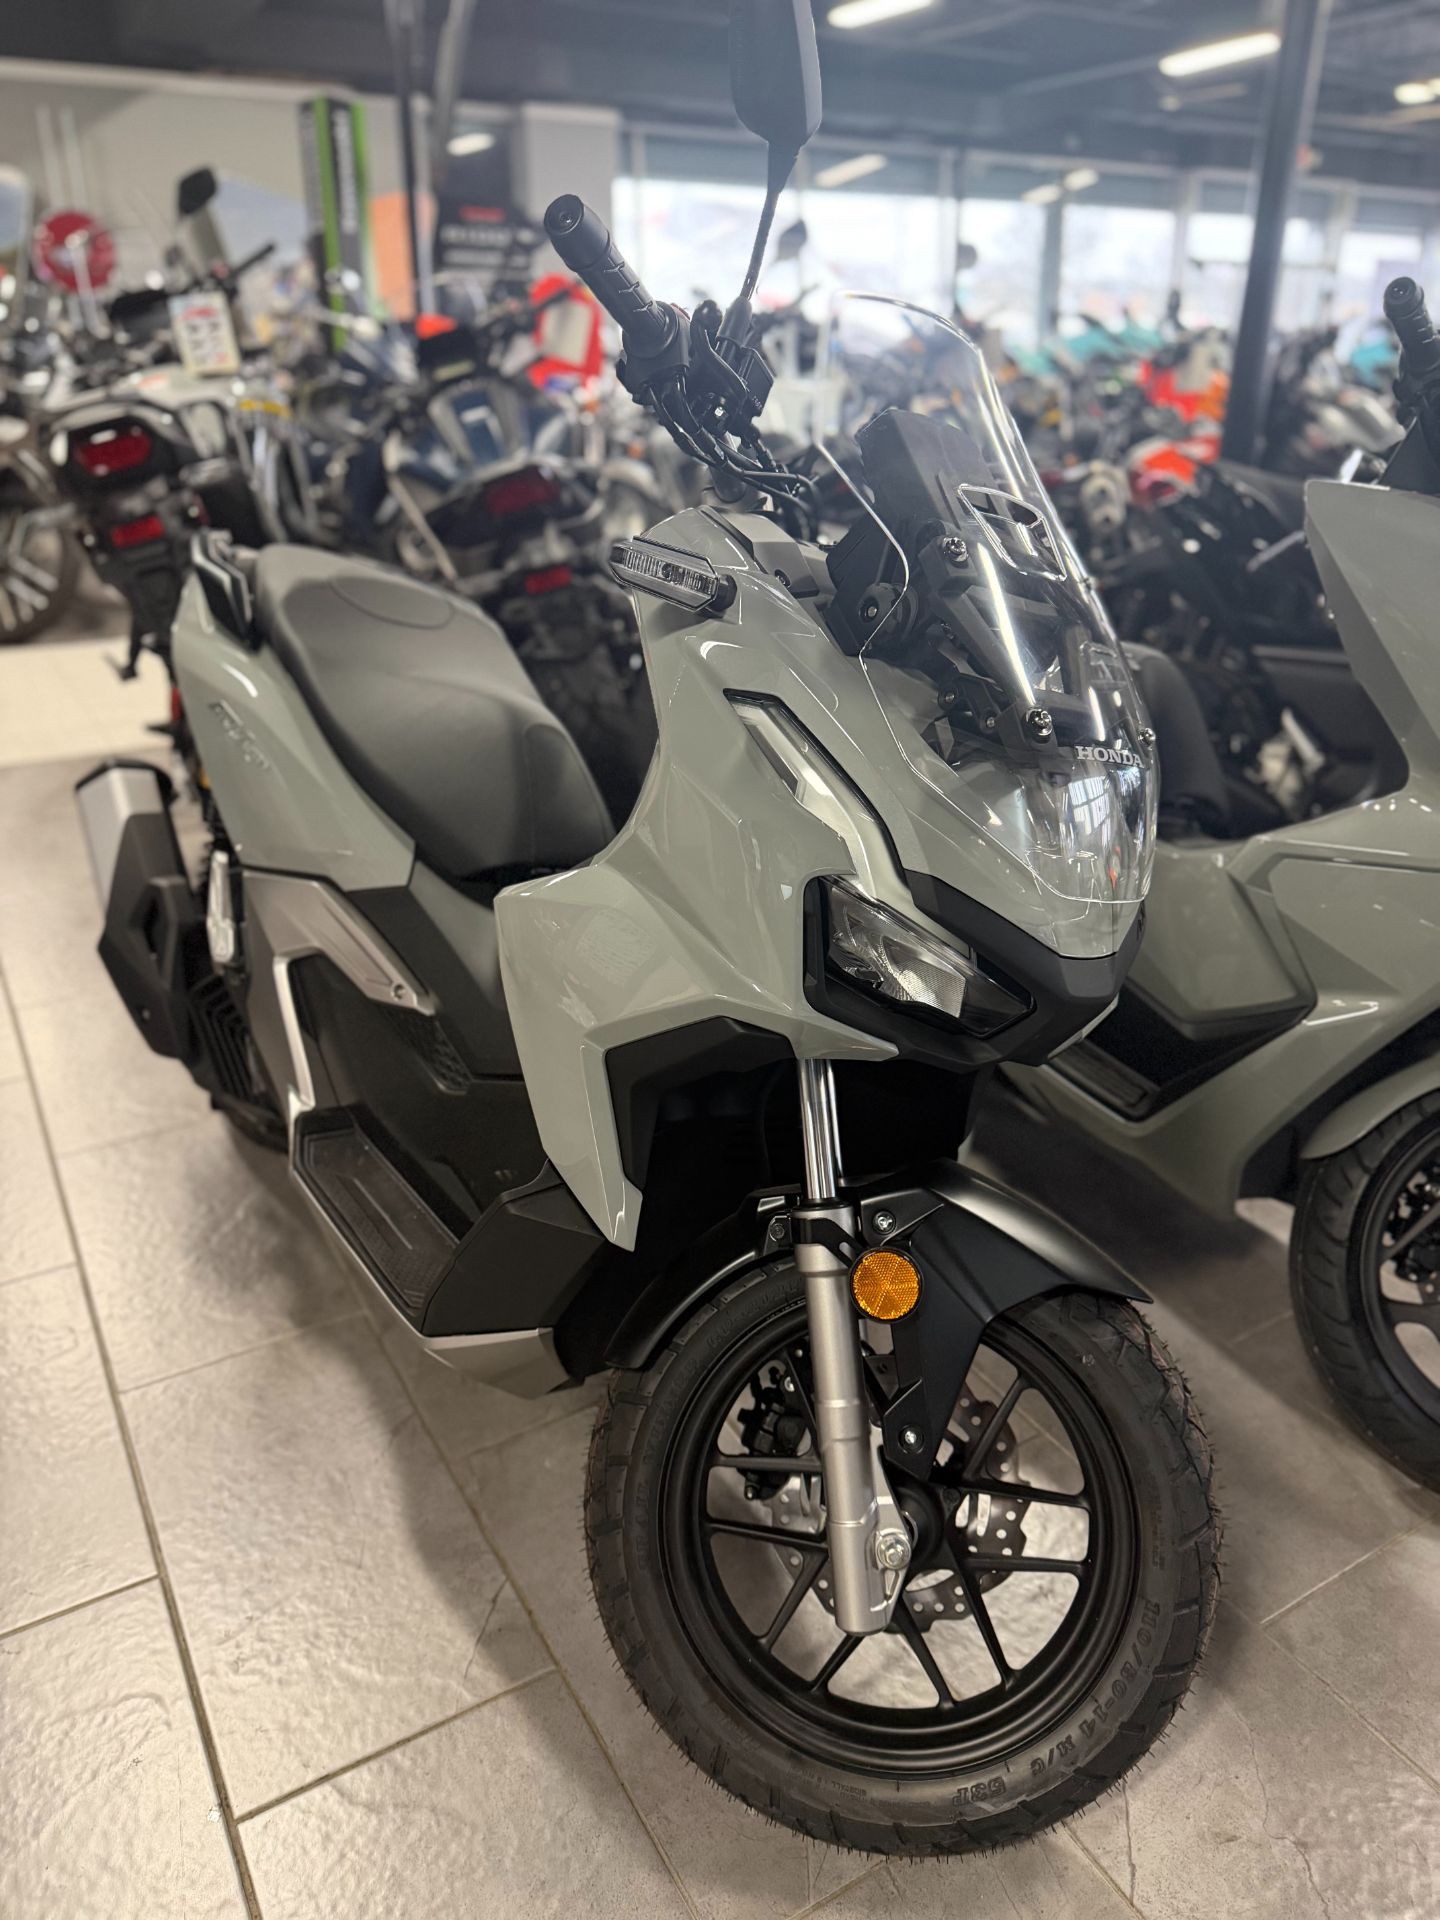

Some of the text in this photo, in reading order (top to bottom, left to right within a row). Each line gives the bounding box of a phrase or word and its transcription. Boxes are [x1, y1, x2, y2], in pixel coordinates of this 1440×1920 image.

[1075, 745, 1144, 769] HONDA
[1078, 1599, 1161, 1739] 110/80-14
[952, 1777, 1007, 1807] 53P
